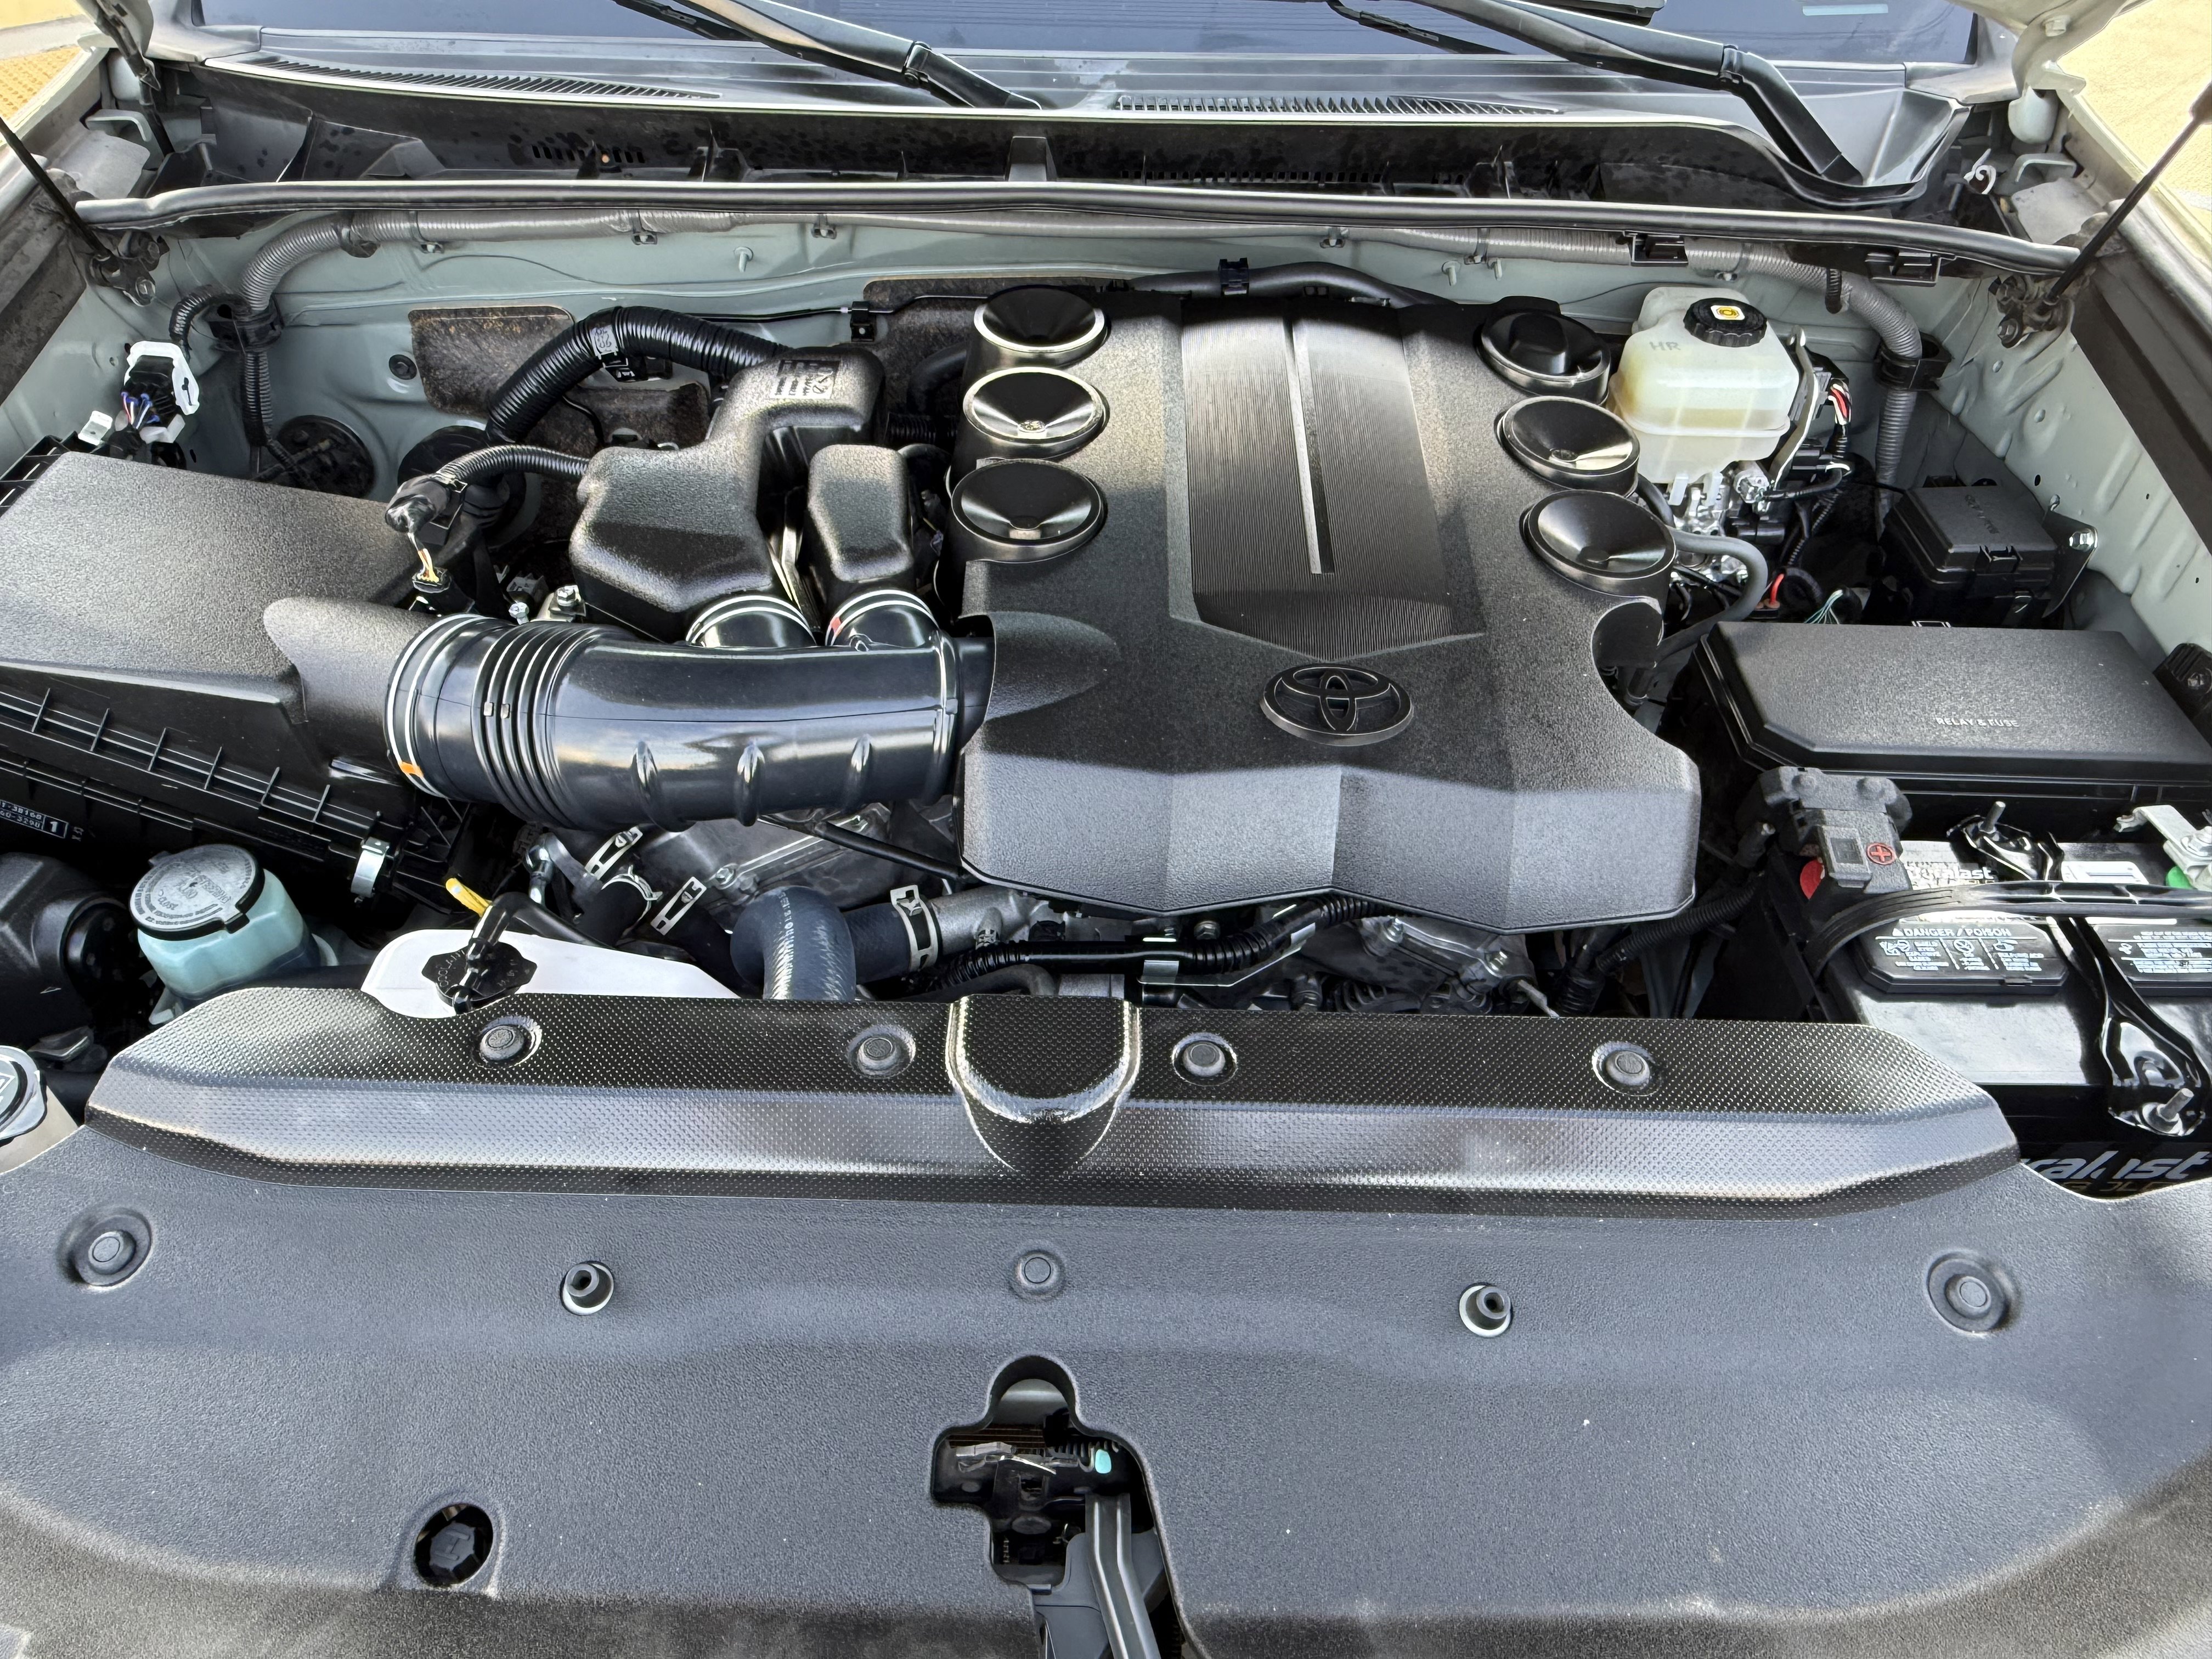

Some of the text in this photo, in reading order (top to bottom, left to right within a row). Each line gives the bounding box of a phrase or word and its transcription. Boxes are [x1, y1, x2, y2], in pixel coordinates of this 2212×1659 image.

[1935, 716, 1973, 726] RELAY
[1988, 719, 2019, 727] FUSE
[1903, 928, 1955, 936] DANGER
[1967, 928, 2012, 936] POISON
